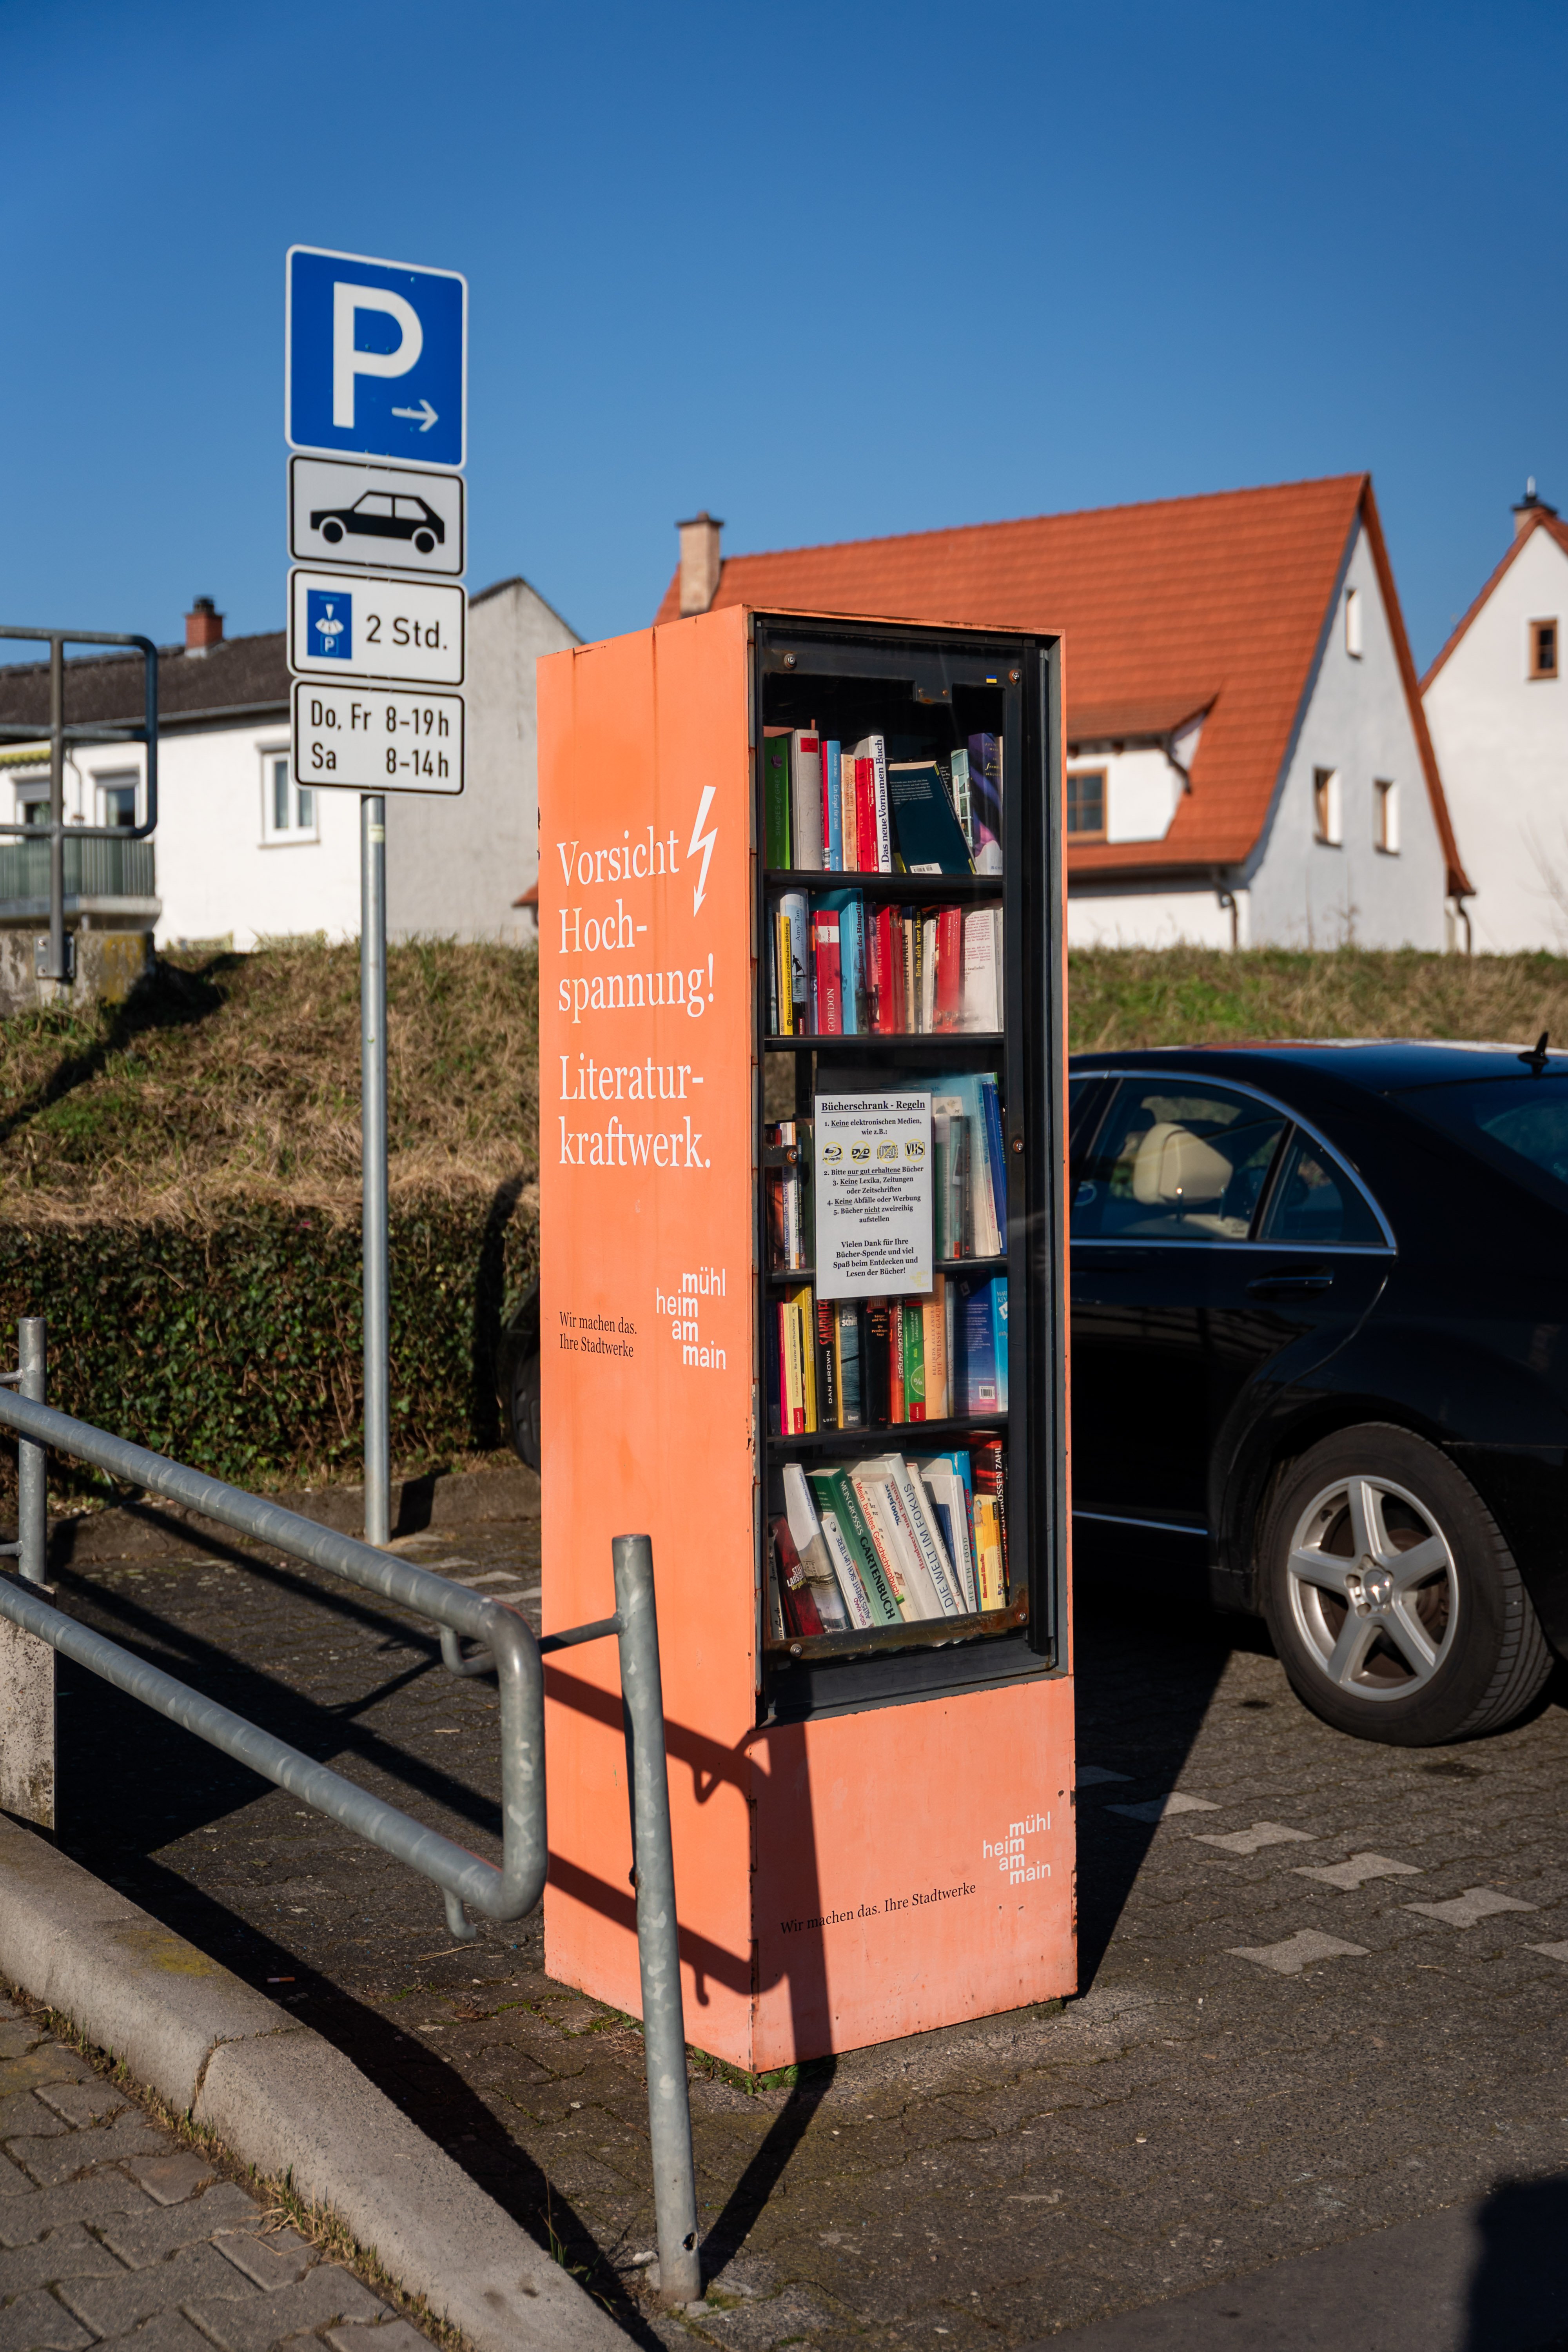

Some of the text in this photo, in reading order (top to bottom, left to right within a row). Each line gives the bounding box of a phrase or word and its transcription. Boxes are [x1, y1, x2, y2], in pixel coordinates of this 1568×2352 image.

[334, 281, 423, 429] P
[366, 614, 447, 650] 2 Std.
[311, 700, 341, 731] Do,
[351, 702, 372, 731] Fr
[311, 742, 336, 771] Sa
[875, 739, 884, 764] Buch
[878, 767, 887, 818] Vornamen
[557, 825, 679, 887] Vorsicht
[881, 844, 889, 863] Das
[559, 898, 647, 954] Hoch-
[559, 953, 715, 1024] spannung!
[827, 988, 835, 1032] GORDON
[559, 1053, 704, 1100] Literatur-
[822, 1101, 889, 1111] Bücherschrank
[896, 1100, 925, 1110] Regeln
[558, 1116, 711, 1168] kraftwerk.
[906, 1143, 924, 1154] VHS
[833, 1261, 850, 1269] Spaß
[869, 1258, 904, 1266] Entdecken
[836, 1249, 887, 1258] Bücher-Spende
[682, 1267, 726, 1296] mühl
[656, 1287, 698, 1318] heim
[559, 1311, 637, 1334] Wir machen das.
[672, 1320, 699, 1342] am
[560, 1334, 634, 1357] Ihre Stadtwerke
[683, 1340, 726, 1369] main
[804, 1488, 812, 1507] Flughafen
[885, 1483, 902, 1526] 7000 Jahre
[855, 1482, 900, 1597] Mein buntes Geschichtenbuch
[890, 1480, 925, 1571] Handwerk und Technik
[840, 1480, 896, 1620] MEIN GROSSES GARTENBUCH
[904, 1483, 954, 1608] DIE WELT IM FOKUS
[844, 1554, 871, 1619] ALLES DREHT SICH UM
[966, 1568, 975, 1602] HEALTH
[1009, 1811, 1051, 1837] mühl
[983, 1835, 1025, 1858] heim
[999, 1853, 1025, 1871] am
[1009, 1860, 1051, 1885] main
[780, 1882, 976, 1934] Wir machen das. Ihre Stadtwerke
